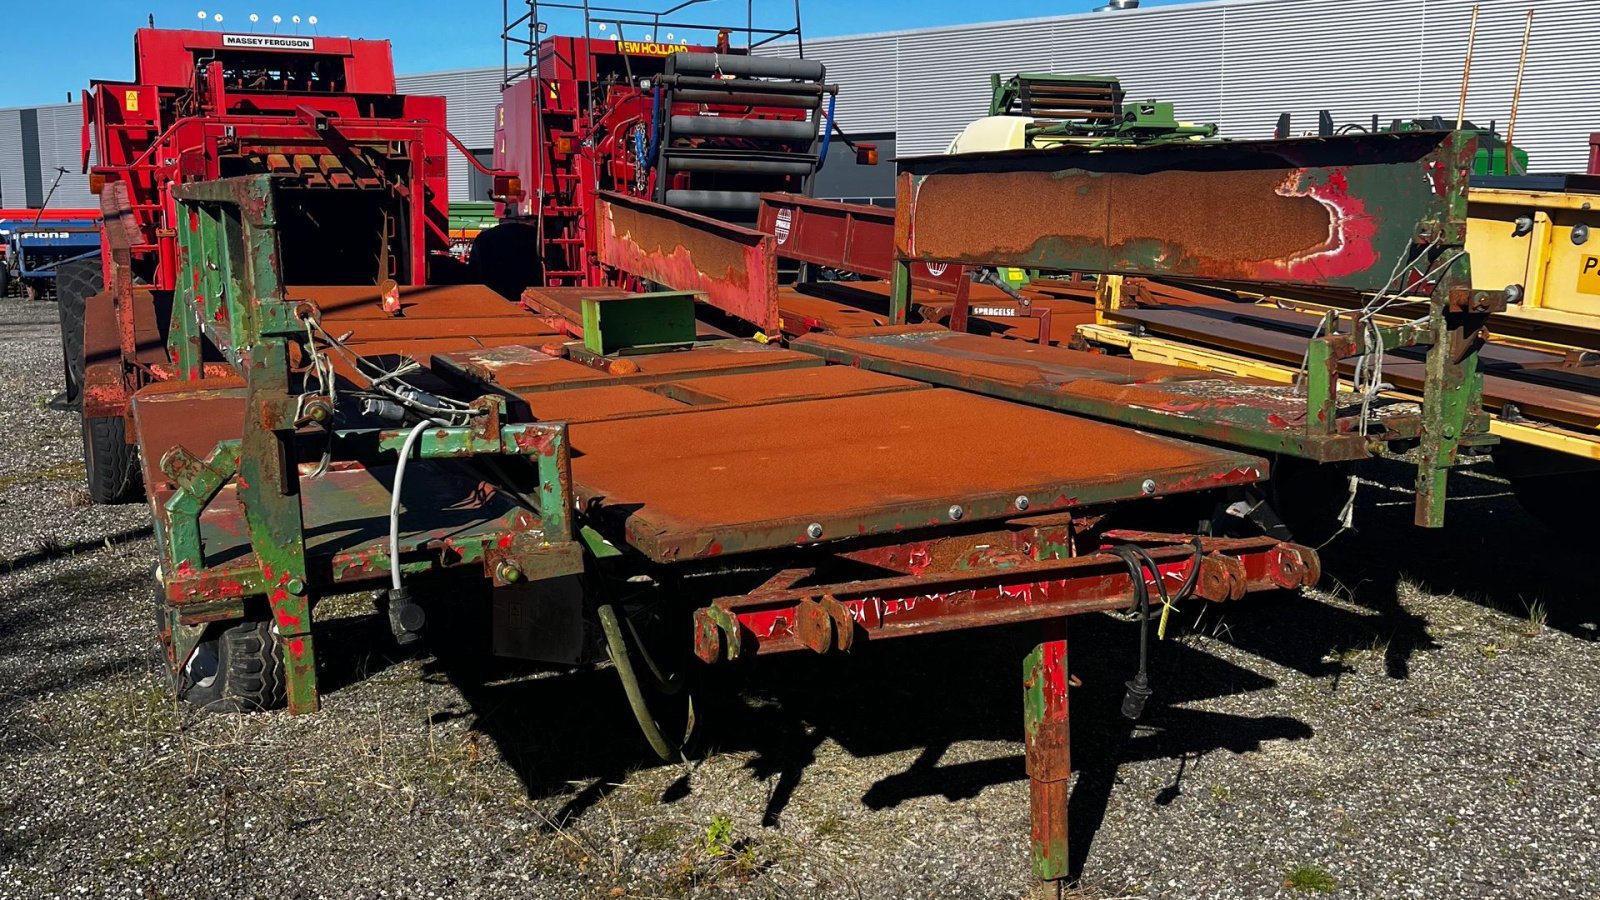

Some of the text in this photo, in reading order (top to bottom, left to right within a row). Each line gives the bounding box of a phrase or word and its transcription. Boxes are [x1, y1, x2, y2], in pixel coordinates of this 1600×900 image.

[227, 37, 310, 47] MASSEY FERGUSON
[618, 41, 688, 55] NEW HOLLAND
